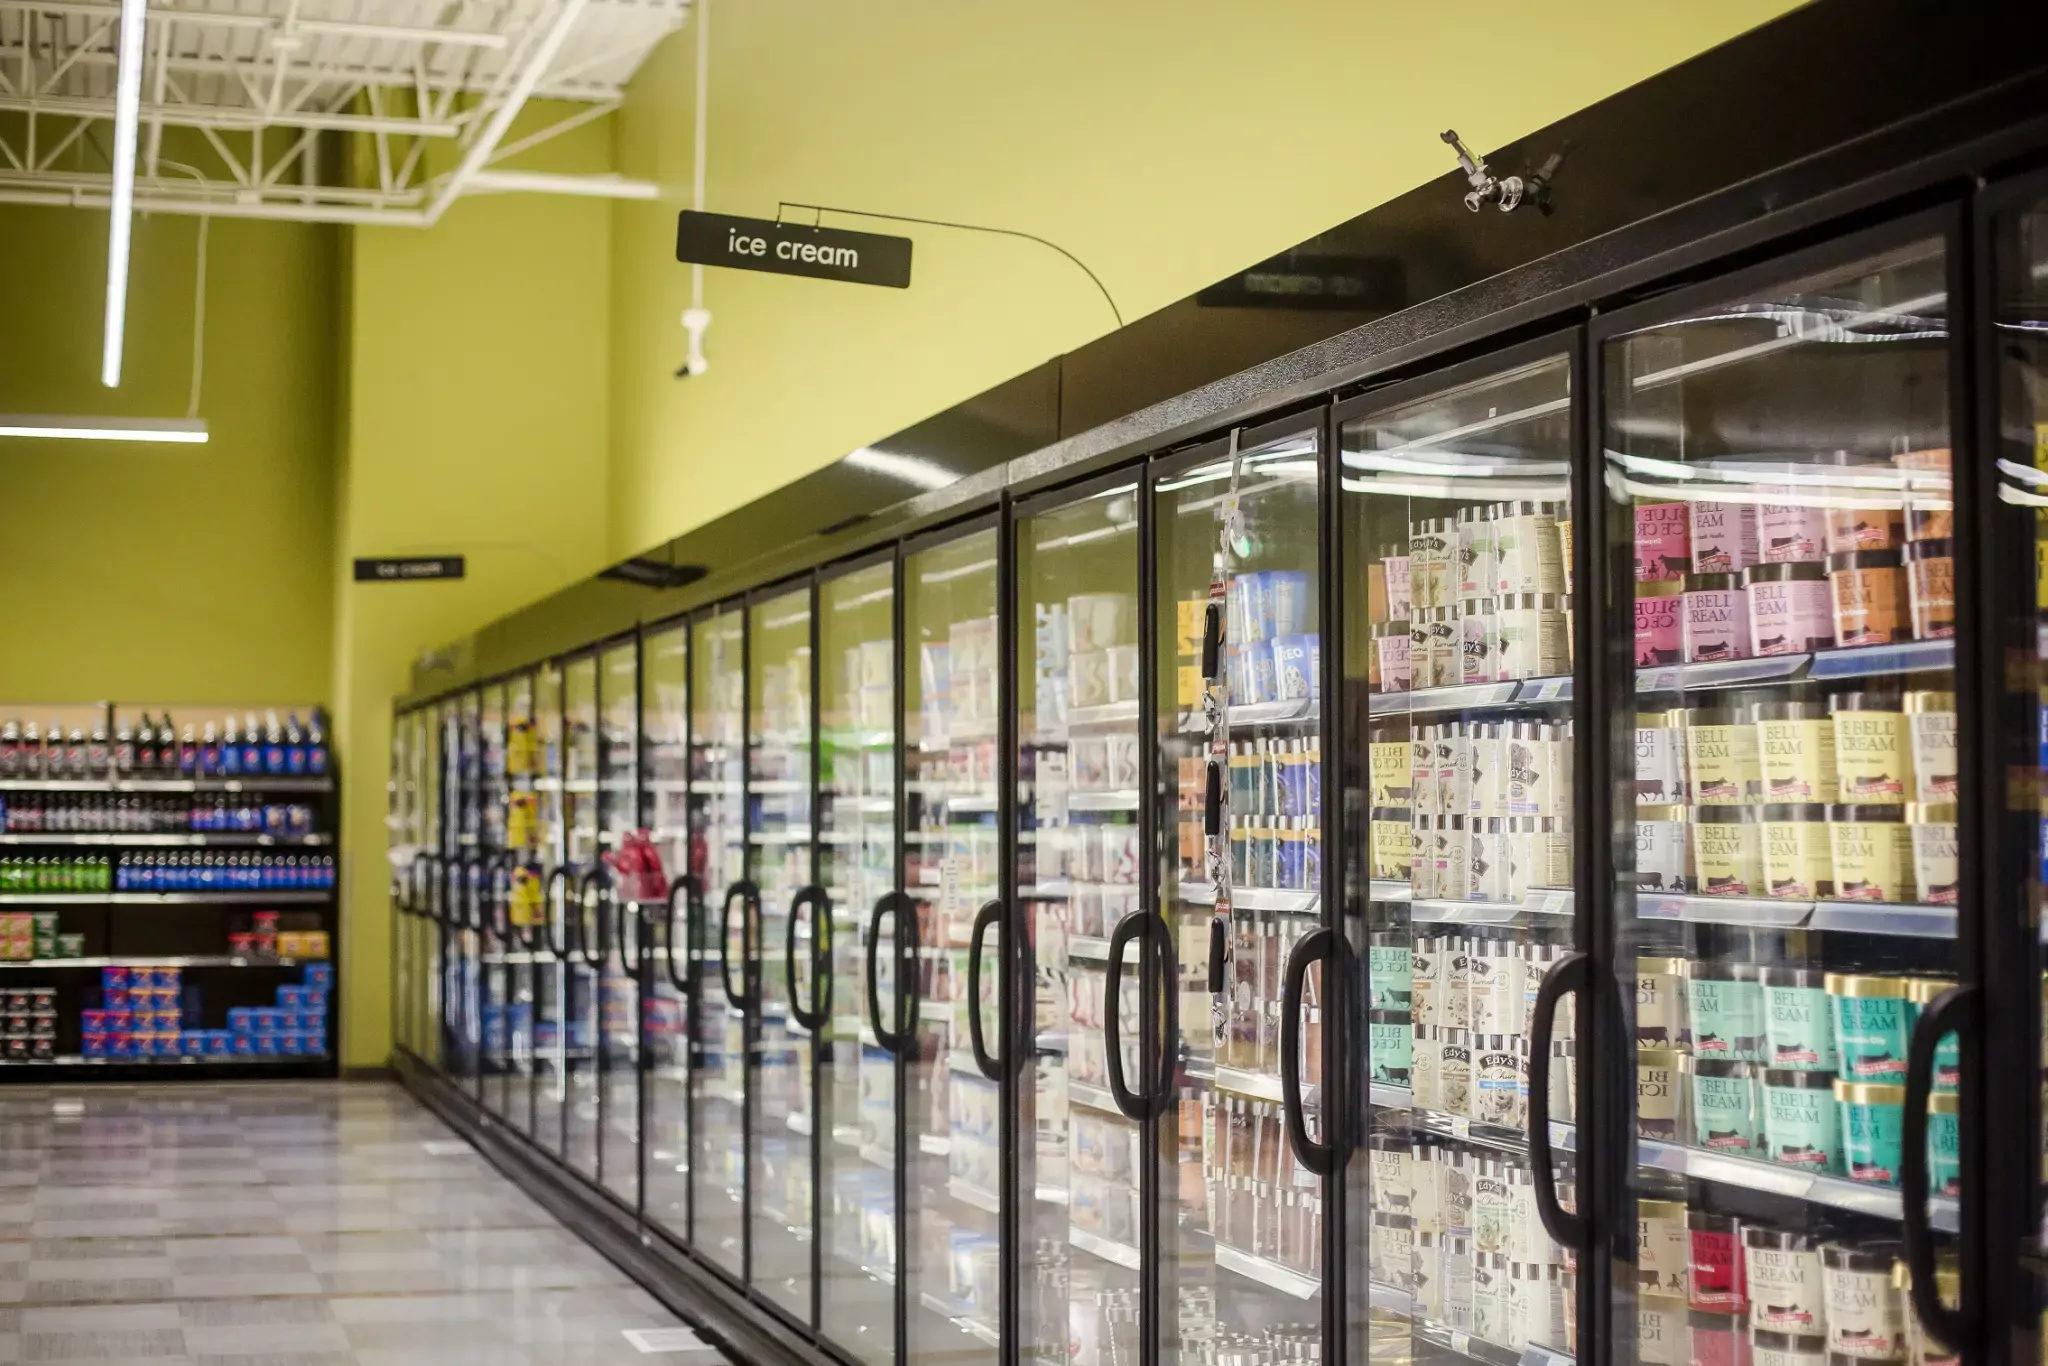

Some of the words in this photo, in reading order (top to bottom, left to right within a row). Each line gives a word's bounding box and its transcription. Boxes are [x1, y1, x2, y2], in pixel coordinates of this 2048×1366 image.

[729, 228, 766, 256] ice
[776, 240, 858, 268] cream
[1697, 594, 1734, 608] BELL
[1688, 609, 1733, 623] REAM
[1281, 647, 1304, 661] REO
[1705, 827, 1741, 840] BELL
[1699, 842, 1741, 855] REAM
[1770, 842, 1799, 856] EAM
[1696, 984, 1719, 998] ELL
[1444, 1047, 1467, 1060] Edy's
[1485, 1053, 1515, 1066] Edy's
[1705, 1079, 1741, 1095] BELL
[1699, 1093, 1742, 1110] REAM
[1780, 1091, 1819, 1109] BELL
[1479, 1180, 1501, 1193] Edy's
[1753, 1265, 1805, 1284] CREAM
